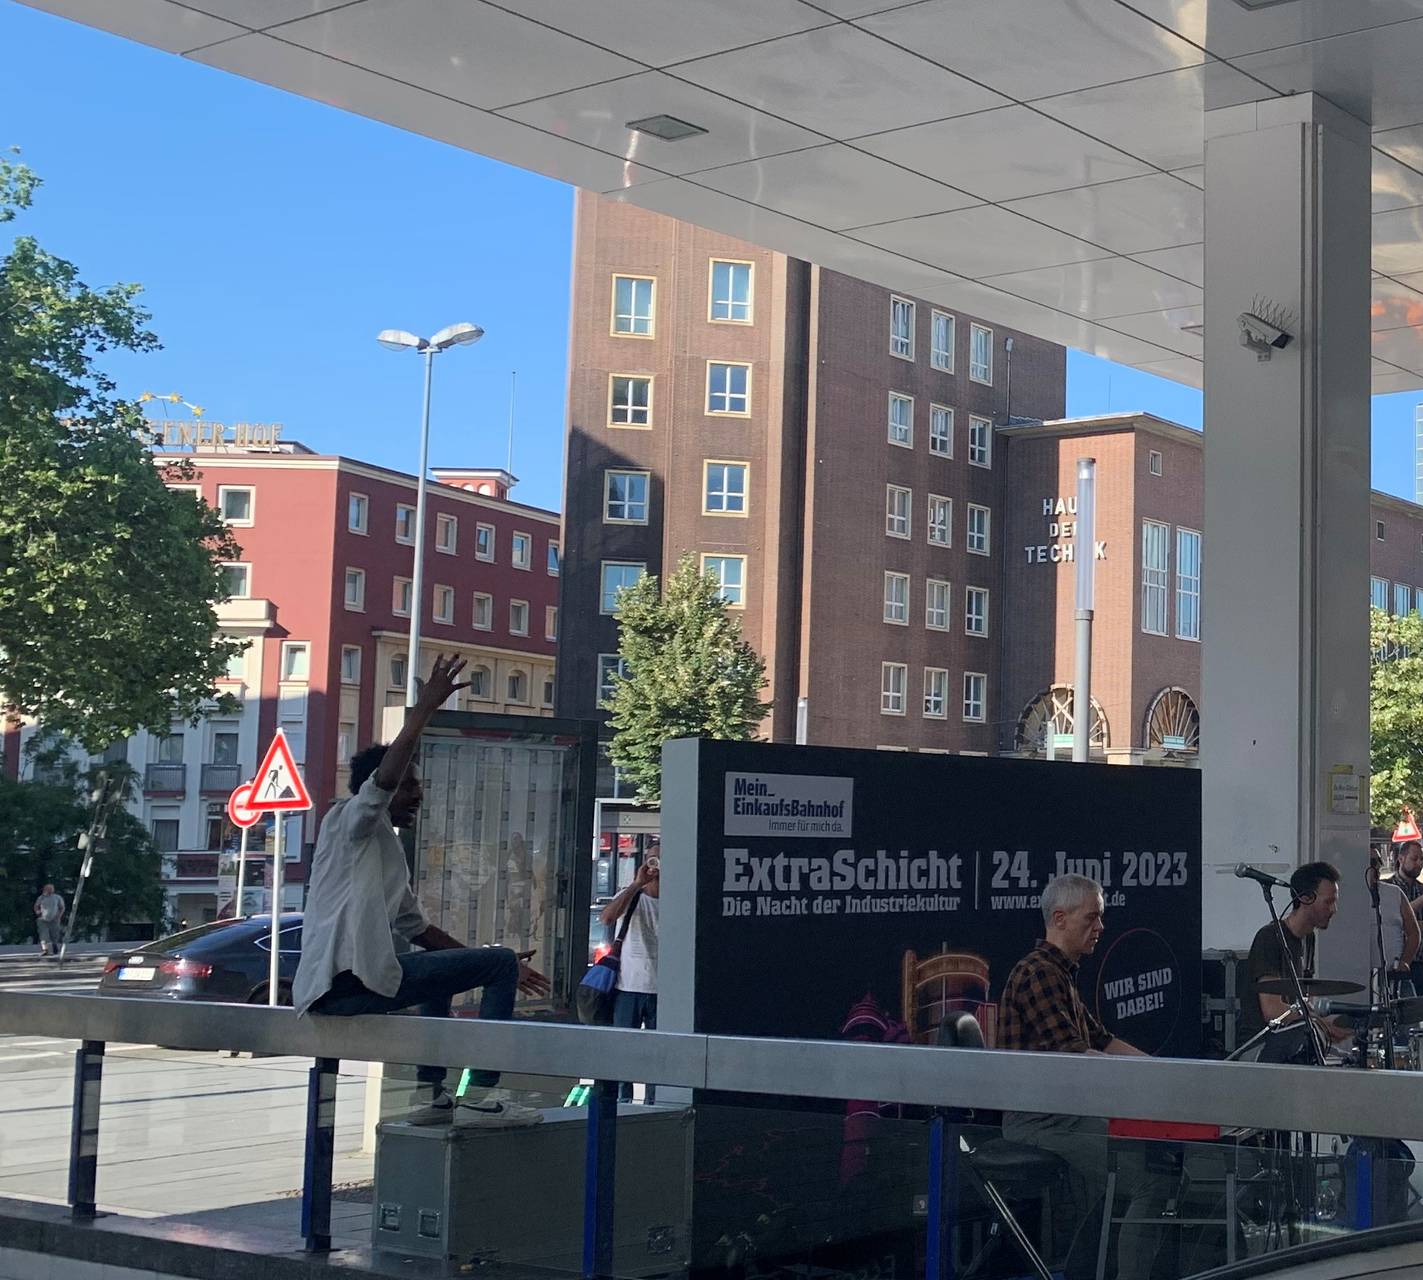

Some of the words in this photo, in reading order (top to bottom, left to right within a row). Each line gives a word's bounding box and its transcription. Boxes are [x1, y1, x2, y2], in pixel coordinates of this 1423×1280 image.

[1043, 496, 1078, 516] HAU
[1024, 541, 1107, 564] TECHK
[733, 797, 845, 818] EinkaufsBahnhof
[723, 848, 962, 891] ExtraSchicht
[991, 851, 1037, 888] 24.
[1122, 851, 1188, 887] 2023
[722, 896, 751, 917] Die
[756, 897, 808, 916] Nacht
[812, 896, 841, 914] der
[845, 894, 961, 914] Industriekultur
[1104, 977, 1134, 1000] WIR
[1138, 967, 1172, 990] SIND
[1116, 991, 1164, 1020] DABEI!
